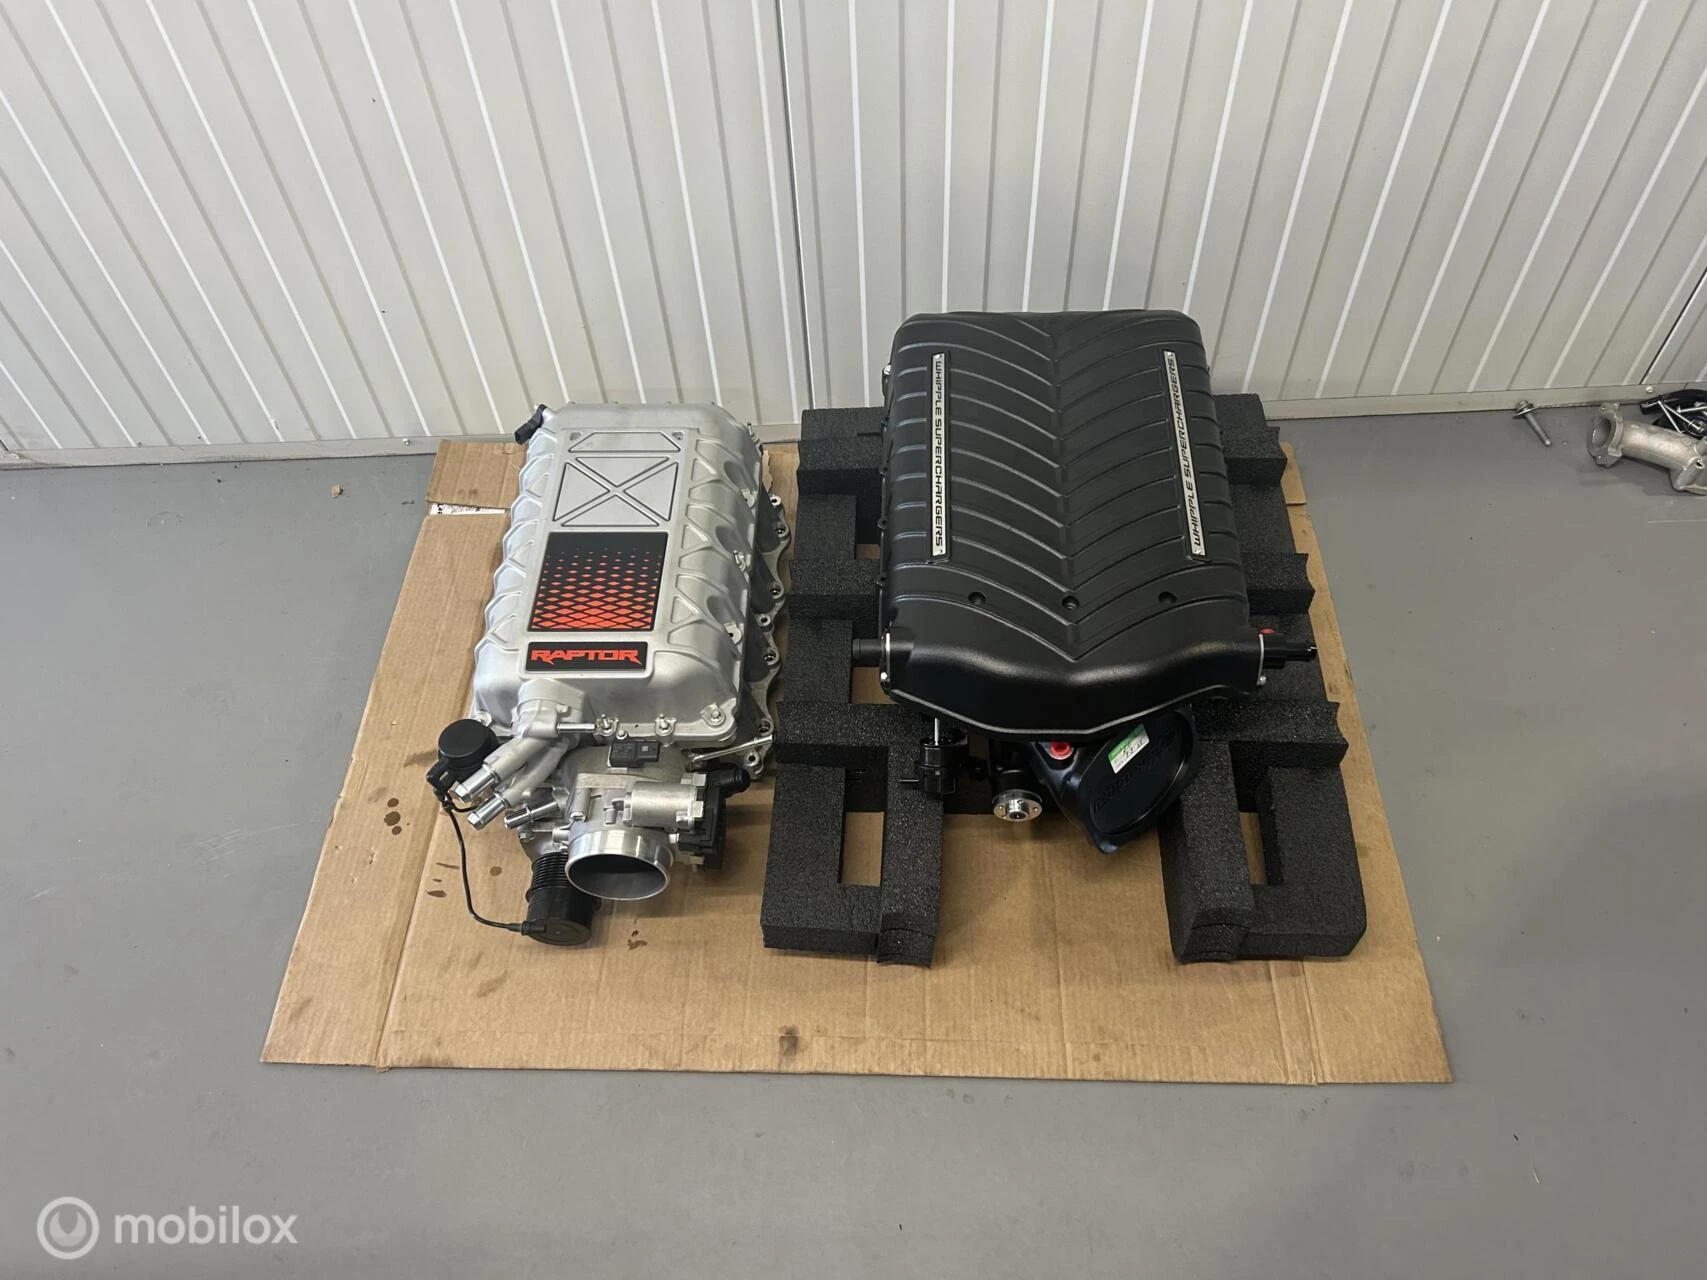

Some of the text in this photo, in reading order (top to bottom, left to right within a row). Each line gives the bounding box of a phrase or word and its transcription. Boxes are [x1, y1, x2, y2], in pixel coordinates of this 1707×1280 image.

[934, 360, 943, 547] WHIPPLE SUPERCHARGERS
[1167, 357, 1201, 547] WHIPPLE SUPERCHARGERS
[530, 649, 642, 665] RAPTOR
